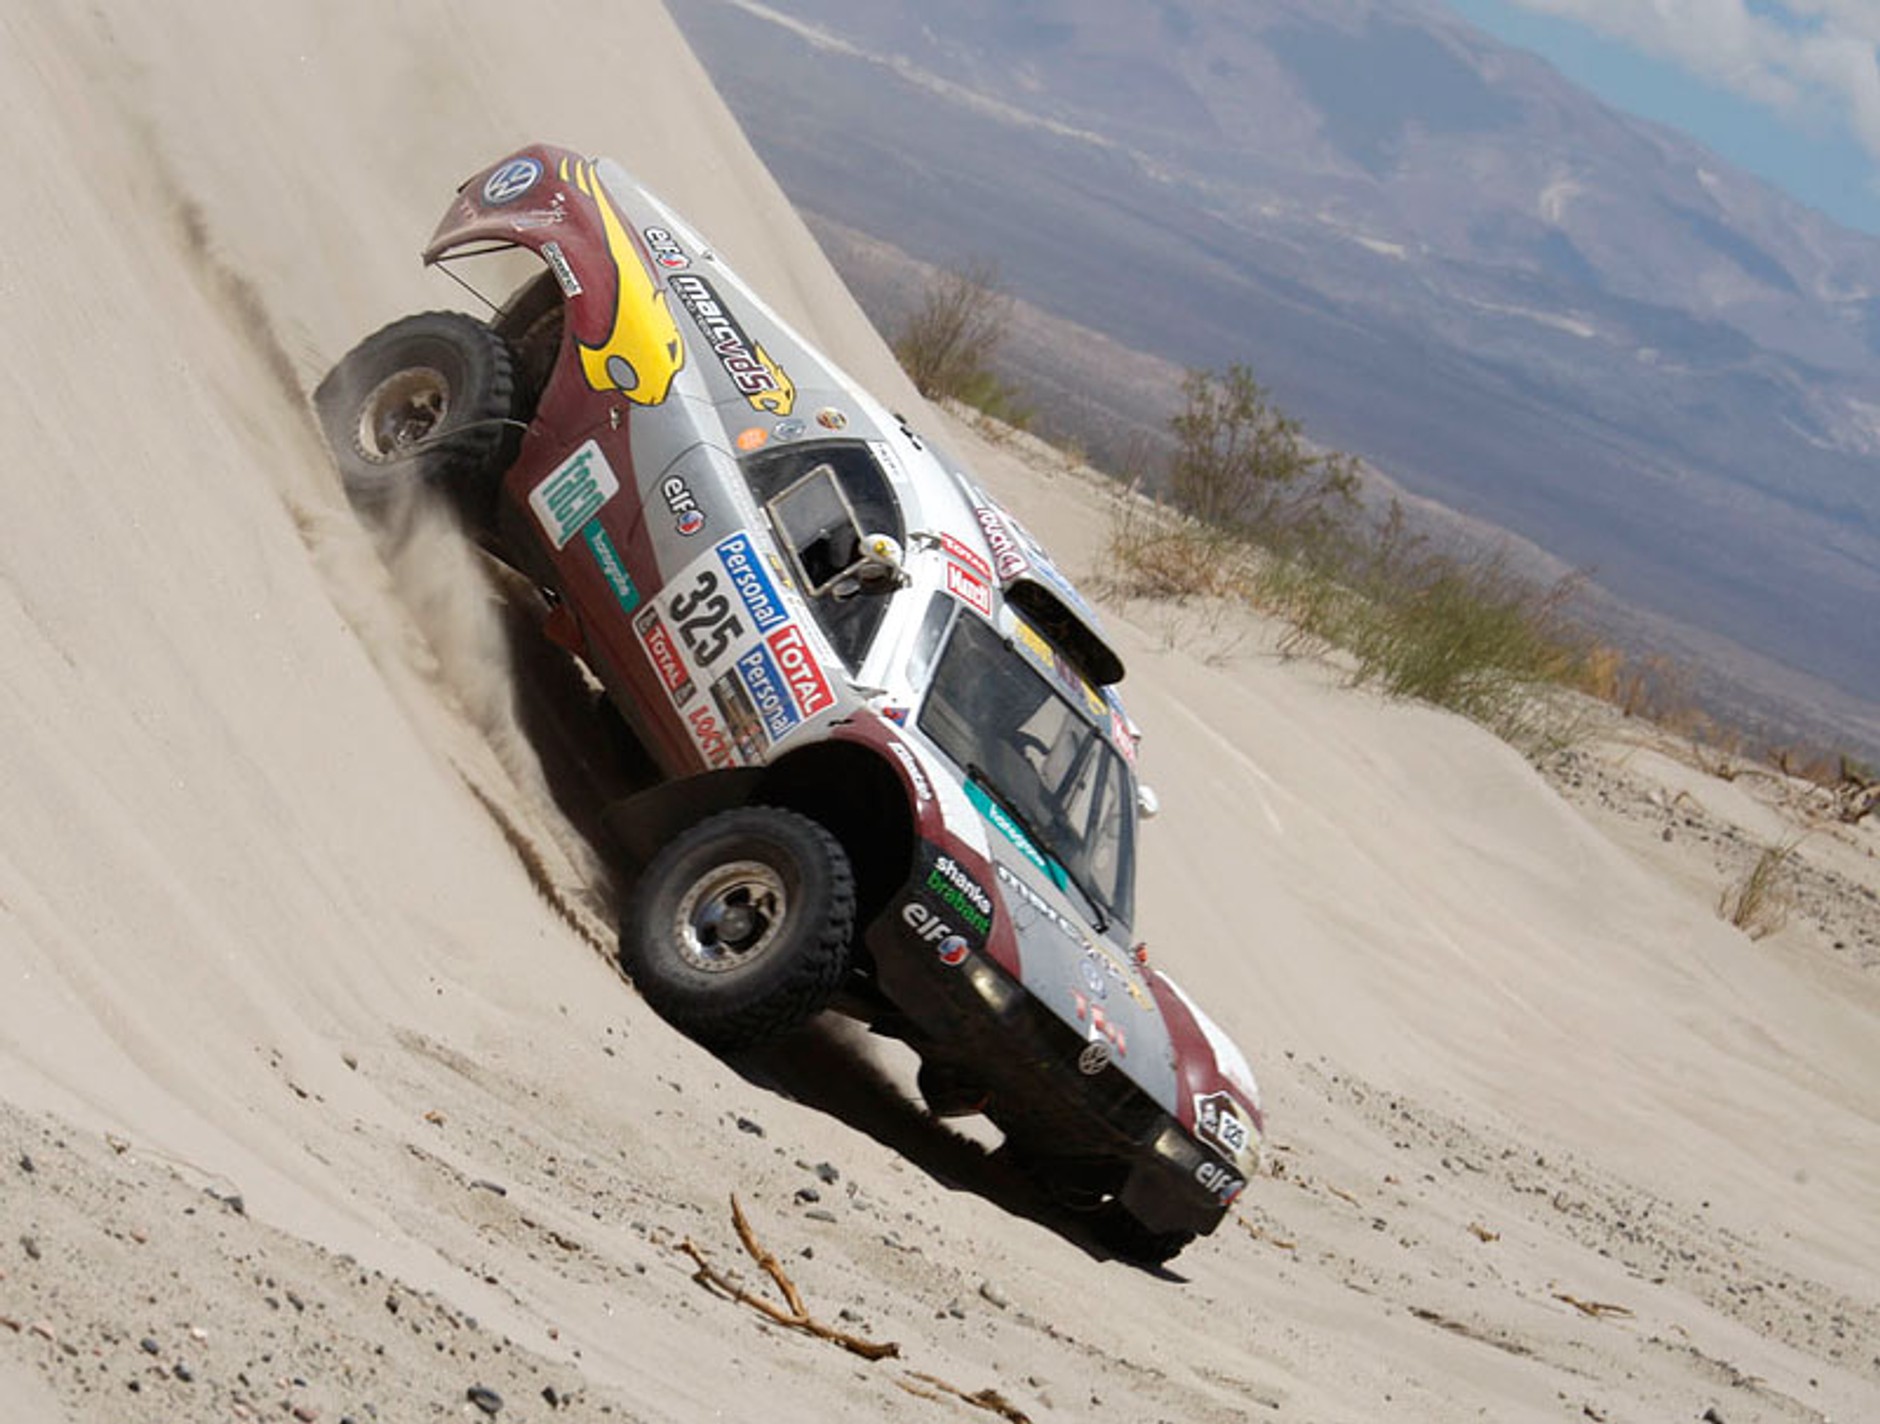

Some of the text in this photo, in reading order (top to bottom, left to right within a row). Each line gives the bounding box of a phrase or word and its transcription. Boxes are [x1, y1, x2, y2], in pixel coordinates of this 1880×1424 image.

[646, 228, 680, 254] elf
[663, 477, 694, 514] elf
[719, 538, 786, 629] Personal
[669, 571, 744, 668] 325
[648, 628, 684, 690] TOTAL
[775, 627, 825, 713] TOTAL
[741, 650, 794, 739] Personal
[902, 903, 952, 940] elf
[1196, 1162, 1229, 1193] elf
